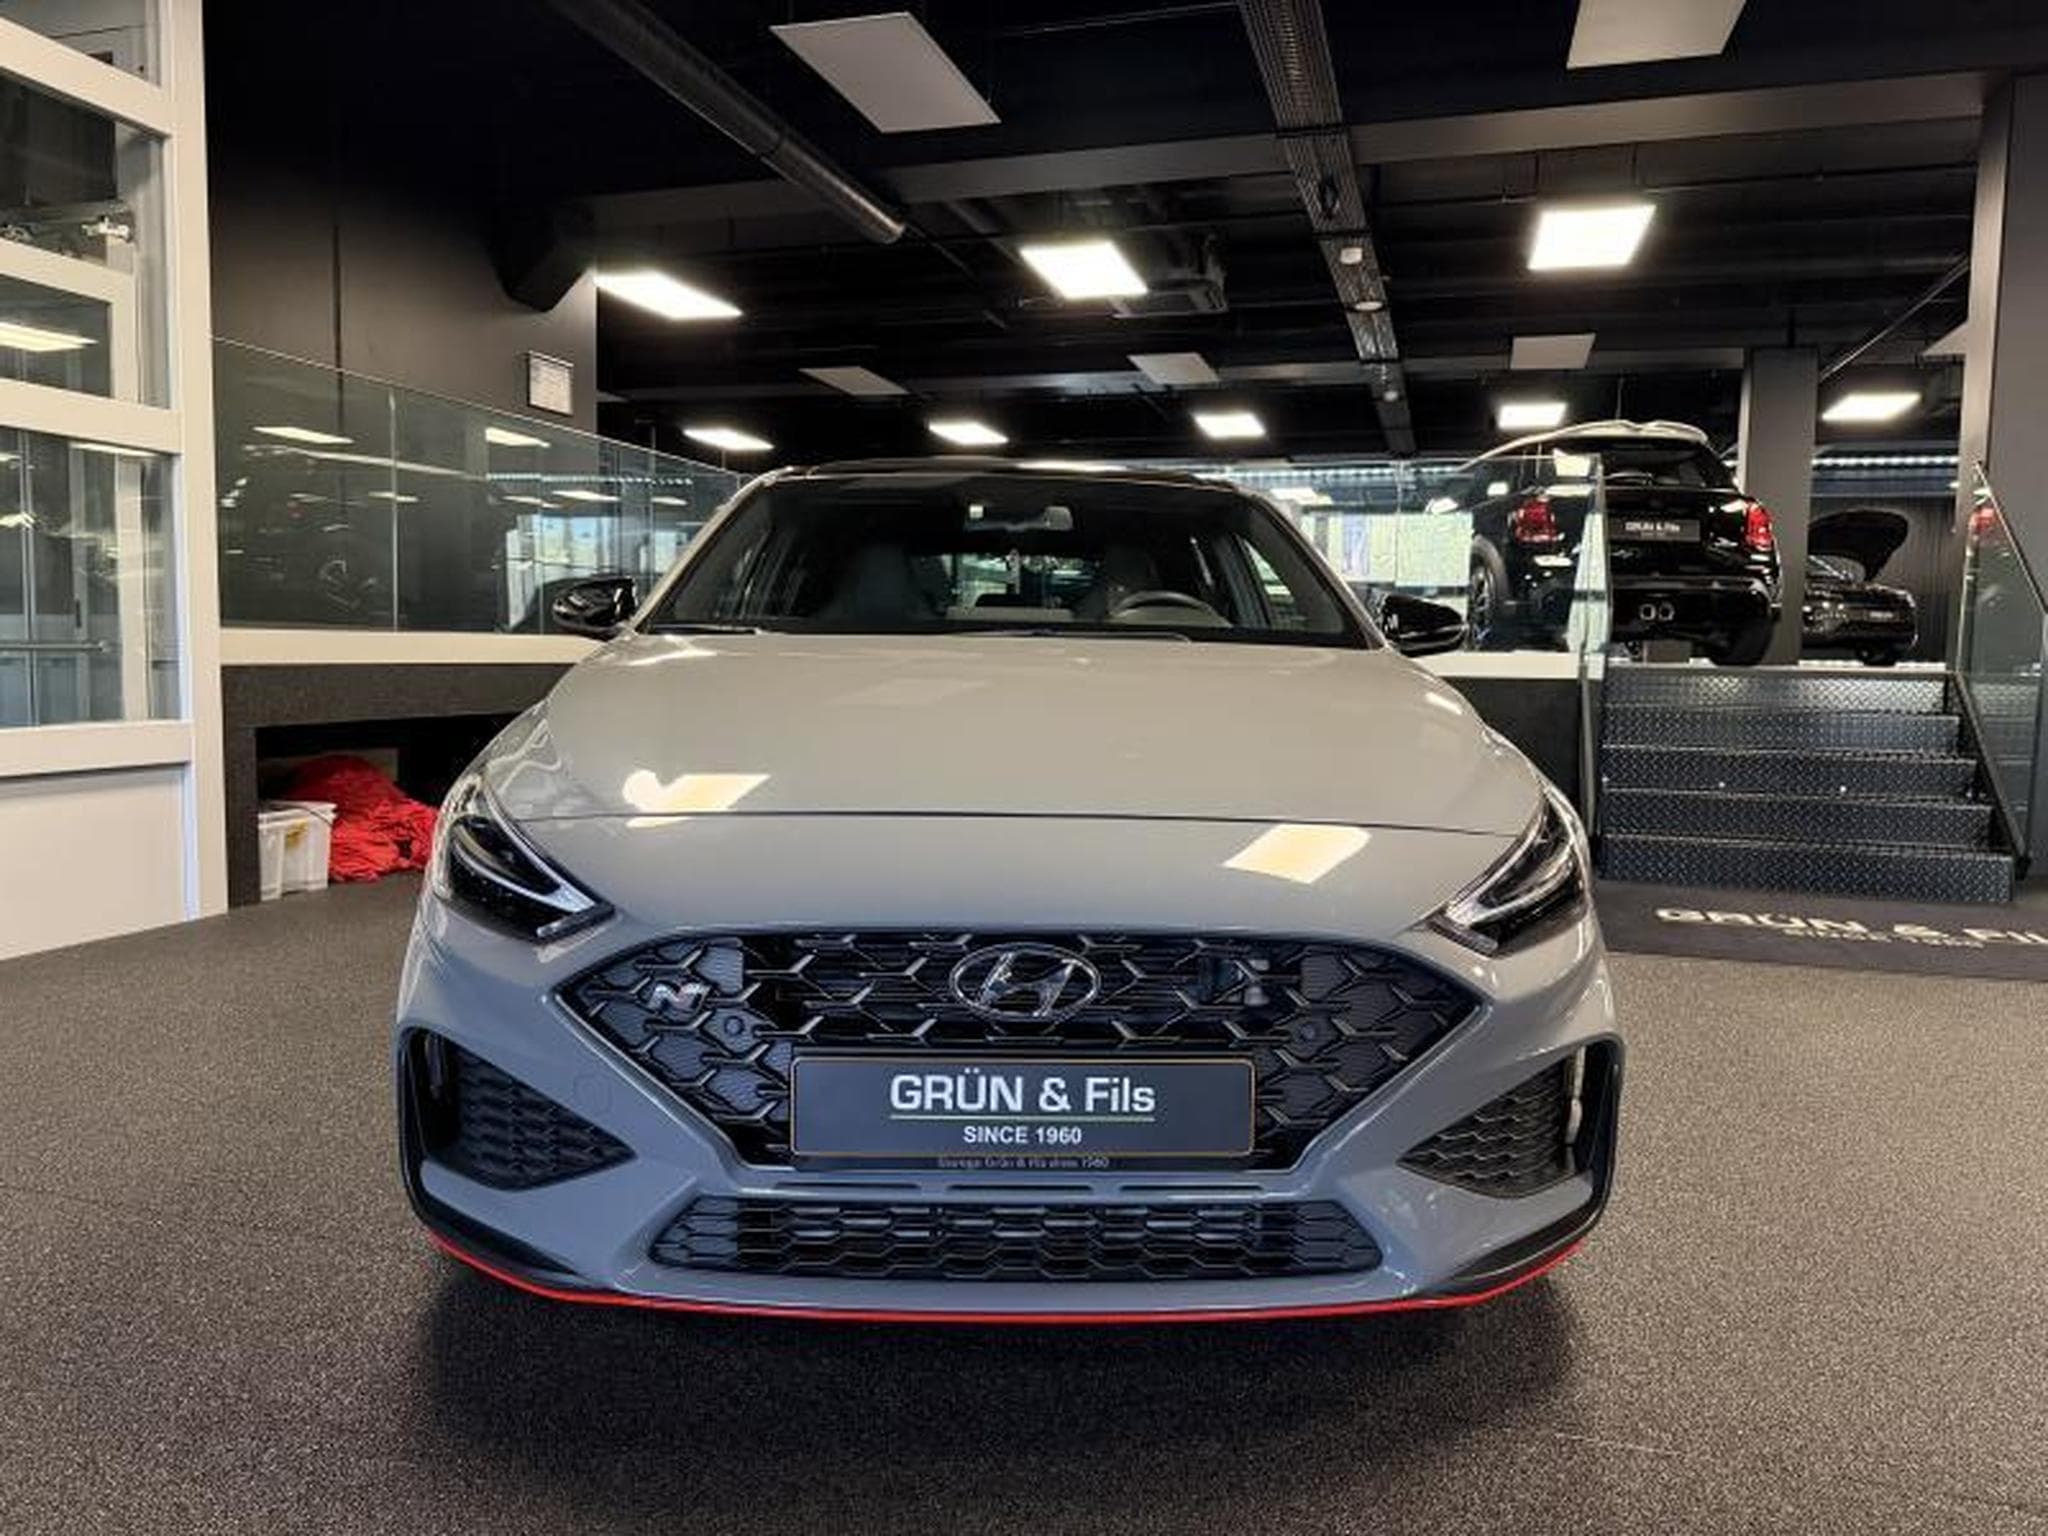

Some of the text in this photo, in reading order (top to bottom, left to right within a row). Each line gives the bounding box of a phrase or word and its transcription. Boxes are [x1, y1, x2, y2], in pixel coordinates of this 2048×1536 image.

[889, 1067, 1156, 1113] GRÜN & Fils
[962, 1126, 1082, 1144] SINCE 1960
